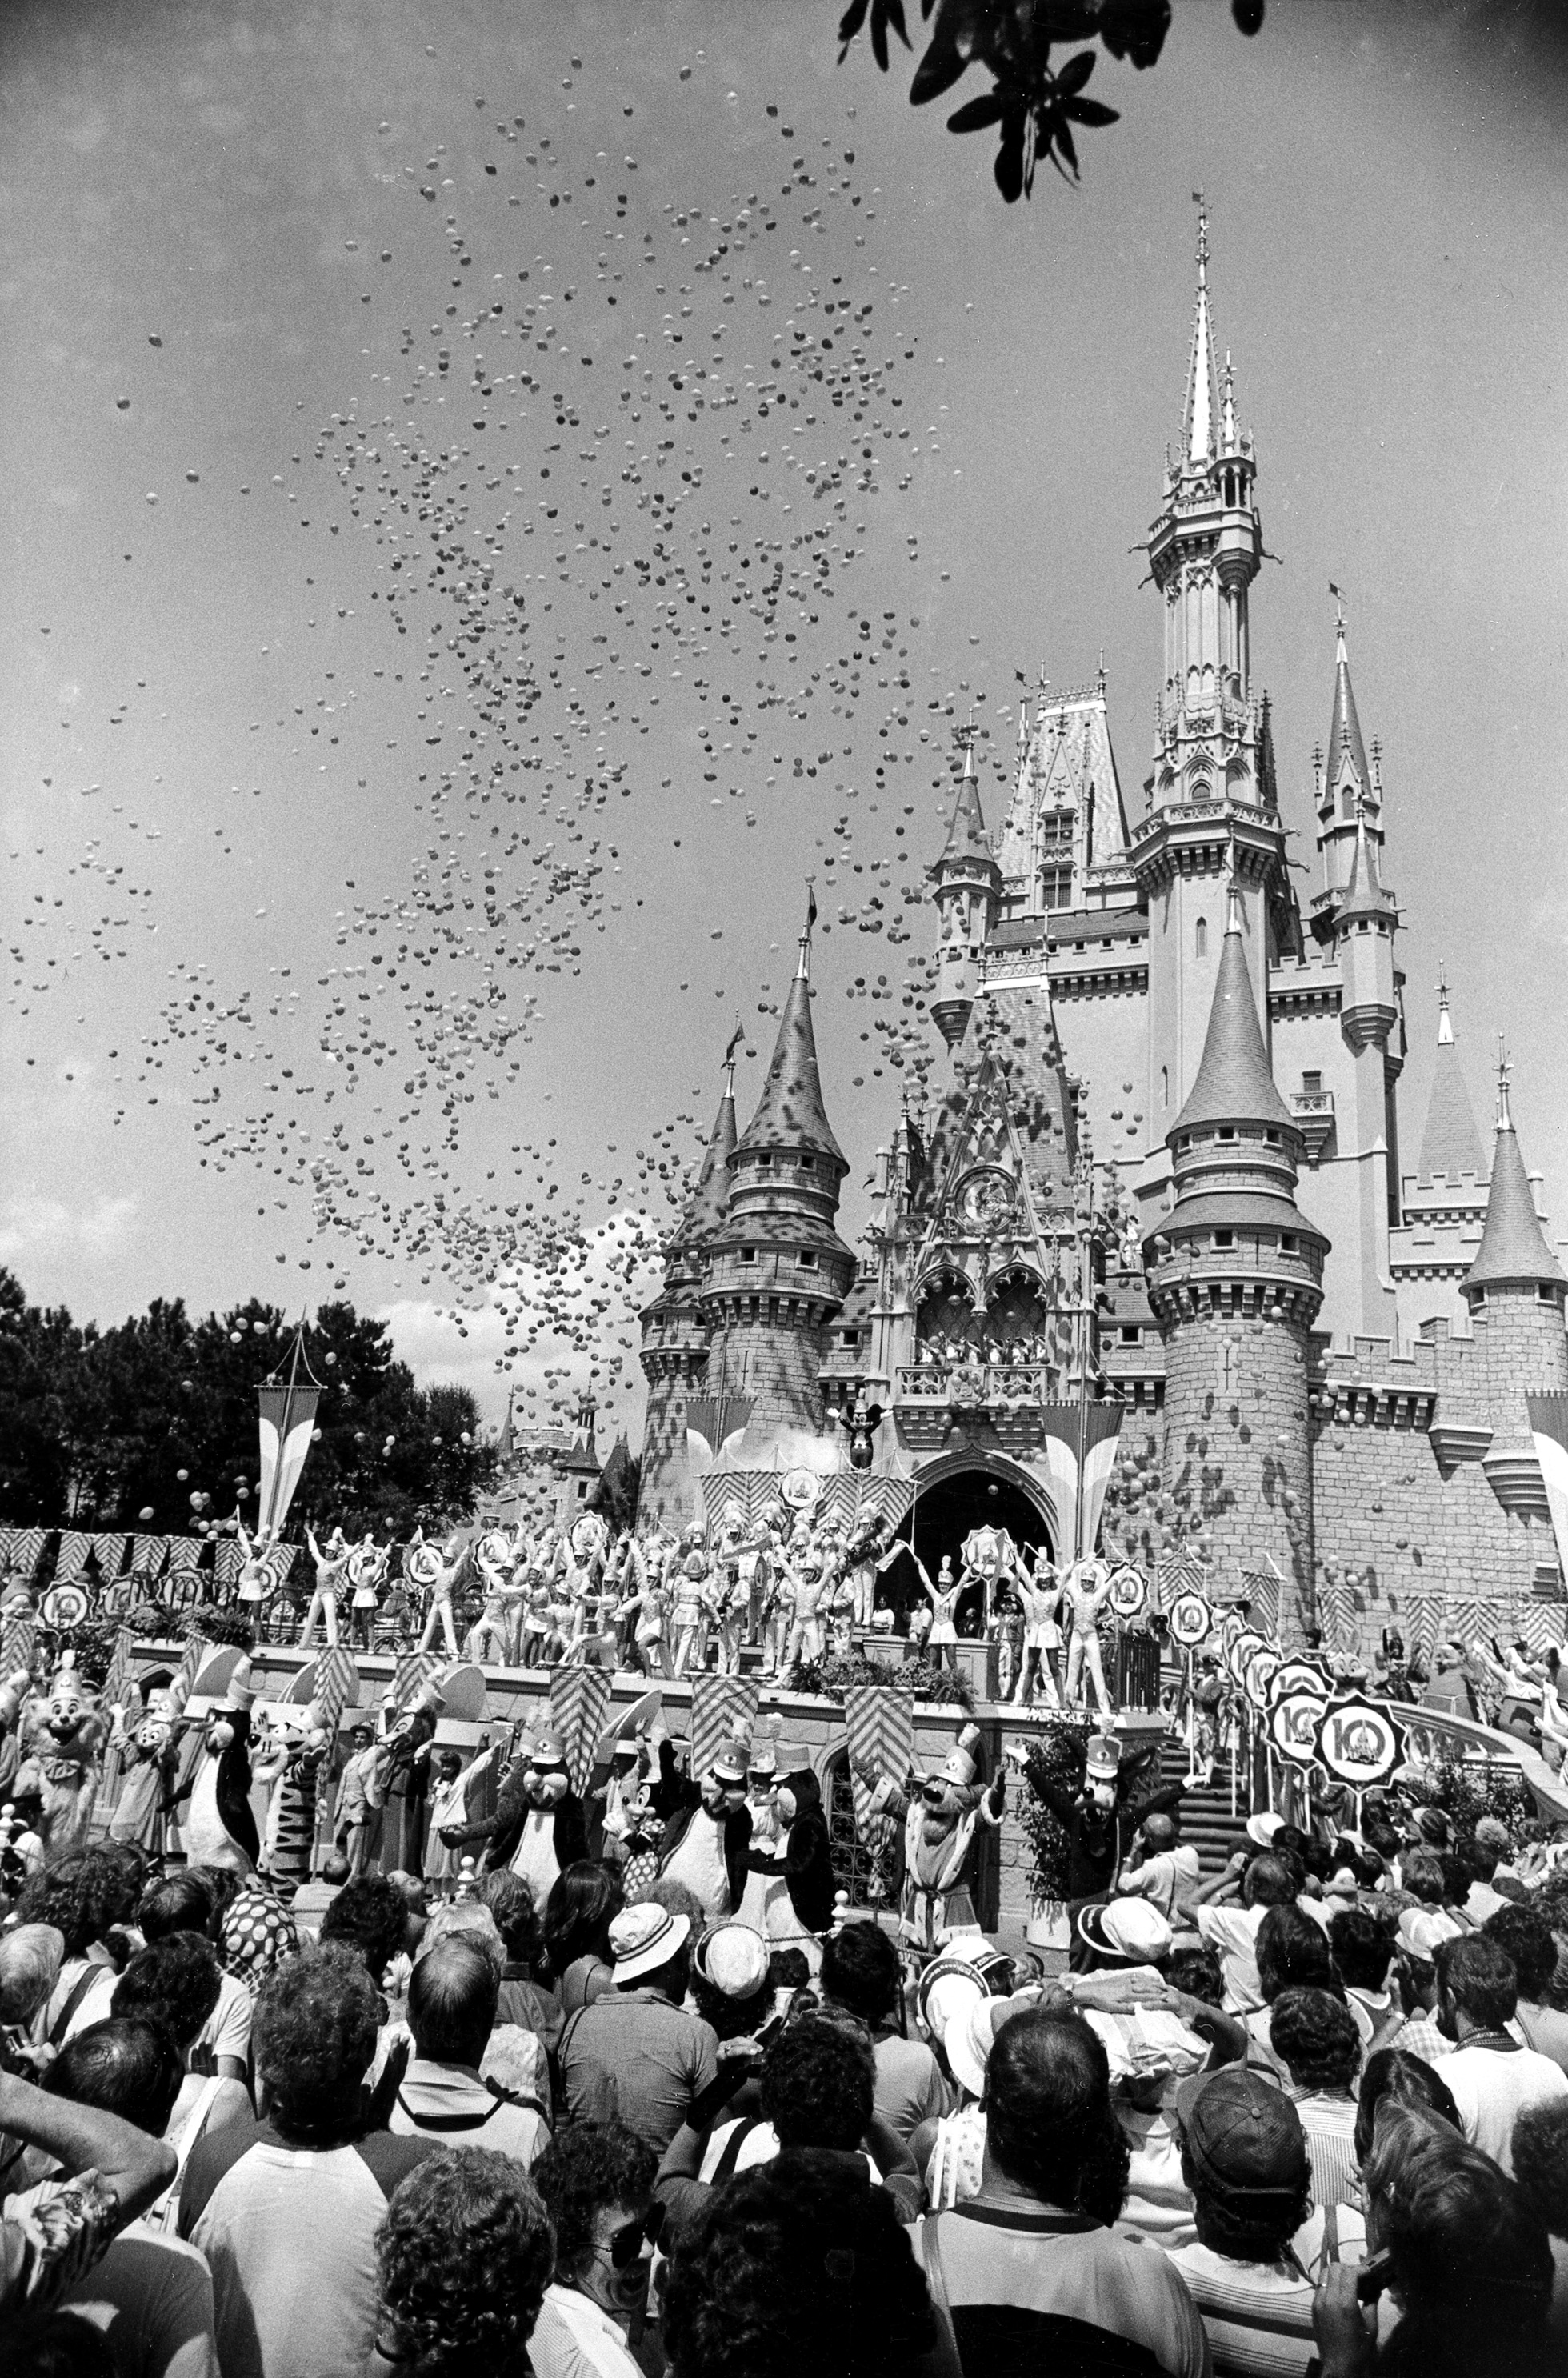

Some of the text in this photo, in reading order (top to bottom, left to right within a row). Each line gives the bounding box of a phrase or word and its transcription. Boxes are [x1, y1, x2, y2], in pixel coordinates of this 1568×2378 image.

[1115, 1576, 1138, 1603] 10
[52, 1592, 81, 1618] 10
[1178, 1605, 1203, 1632] 10
[1332, 1718, 1386, 1765] 10
